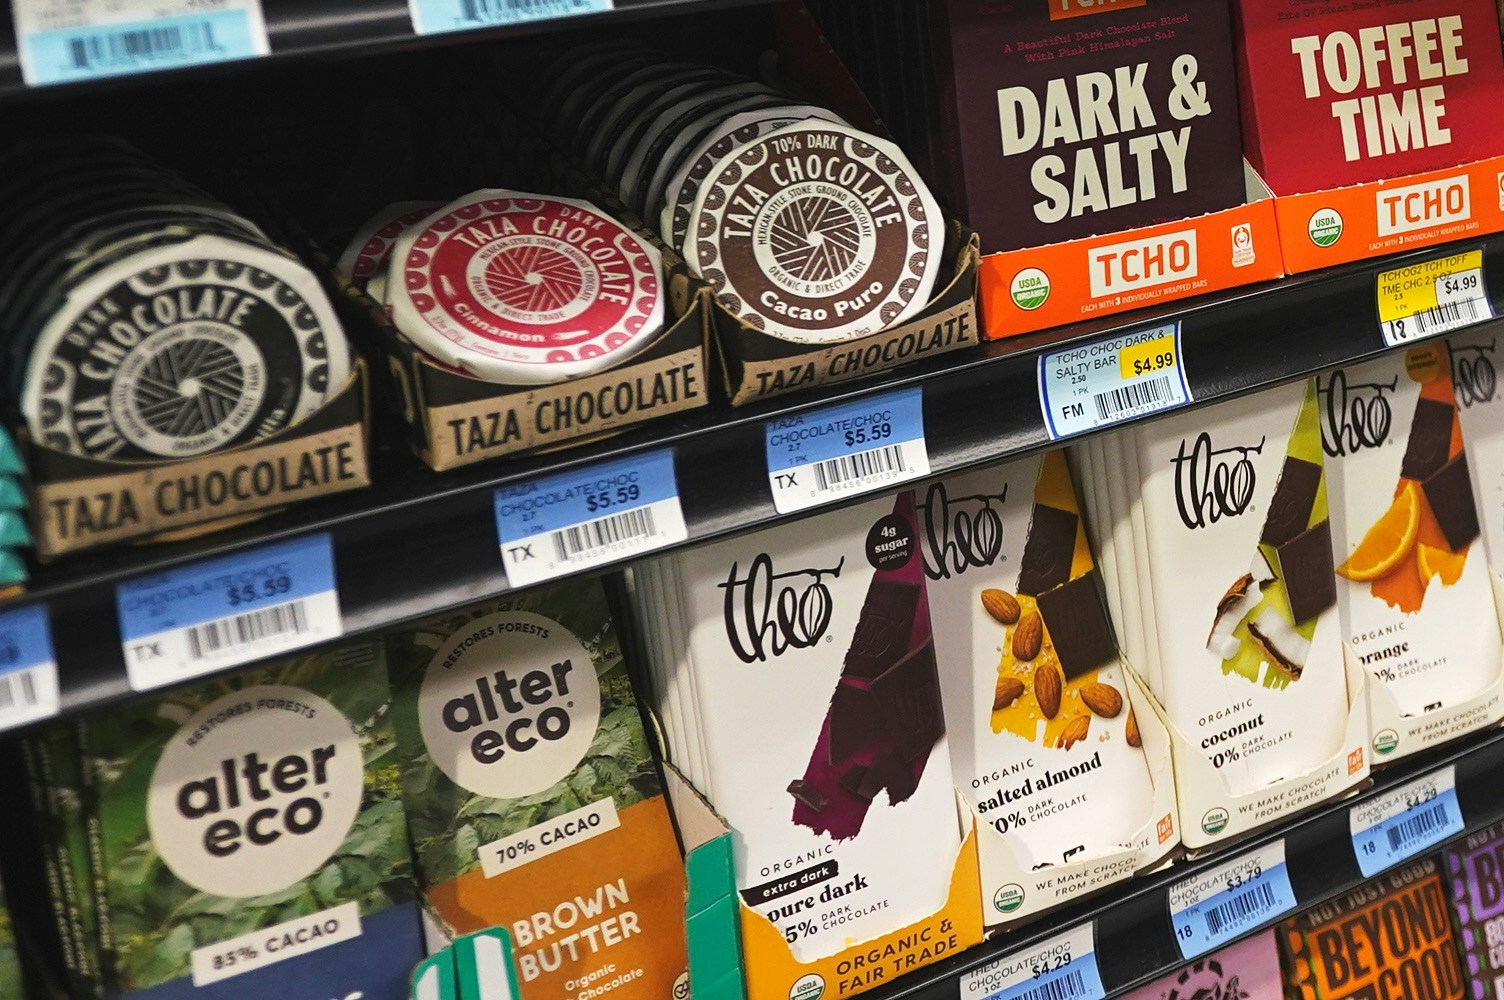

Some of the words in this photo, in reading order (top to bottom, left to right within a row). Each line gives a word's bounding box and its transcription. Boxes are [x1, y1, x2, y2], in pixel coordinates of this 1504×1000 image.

[1291, 14, 1470, 100] TOFFEE
[997, 62, 1157, 157] DARK
[1168, 54, 1212, 121] &
[1330, 84, 1452, 162] TIME
[772, 136, 802, 155] 70%
[807, 134, 839, 150] DARK
[723, 184, 770, 239] TAZA
[770, 154, 902, 228] CHOCOLATE
[1030, 126, 1192, 224] SALTY
[1383, 184, 1465, 227] TCHO
[1096, 239, 1190, 287] TCHO
[1443, 274, 1477, 295] $4.99
[454, 301, 546, 344] Cinnamon
[760, 290, 827, 320] Cacao
[833, 281, 883, 317] Puro
[755, 367, 814, 395] TAZA
[828, 315, 970, 377] CHOCOLATE
[1056, 350, 1087, 364] TCHO
[1090, 340, 1122, 357] CHOC
[1125, 332, 1155, 349] DARK
[1056, 362, 1090, 379] SALTY
[1094, 356, 1116, 369] BAR
[1134, 353, 1173, 375] $4.99
[447, 409, 522, 457] TAZA
[533, 363, 697, 435] CHOCOLATE
[770, 410, 891, 447] CHOCOLATE/CHOC
[1062, 403, 1084, 419] FM
[844, 422, 892, 447] $5.59
[875, 535, 909, 554] sugar
[880, 524, 897, 538] 4g
[716, 552, 845, 665] theo
[441, 656, 573, 734] alter
[470, 705, 571, 766] eco
[1200, 713, 1265, 749] coconut
[972, 758, 1035, 789] ORGANIC
[976, 777, 1033, 815] salted
[1035, 753, 1103, 792] almond
[495, 839, 536, 865] 70%
[540, 812, 602, 846] CACAO
[1226, 867, 1263, 893] $3.79
[512, 879, 630, 948] BROWN
[1318, 884, 1446, 989] BEYOND
[518, 911, 642, 983] BUTTER
[836, 927, 934, 977] ORGANIC
[837, 966, 886, 995] FAIR
[889, 934, 959, 977] TRADE
[1031, 954, 1073, 980] $4.29
